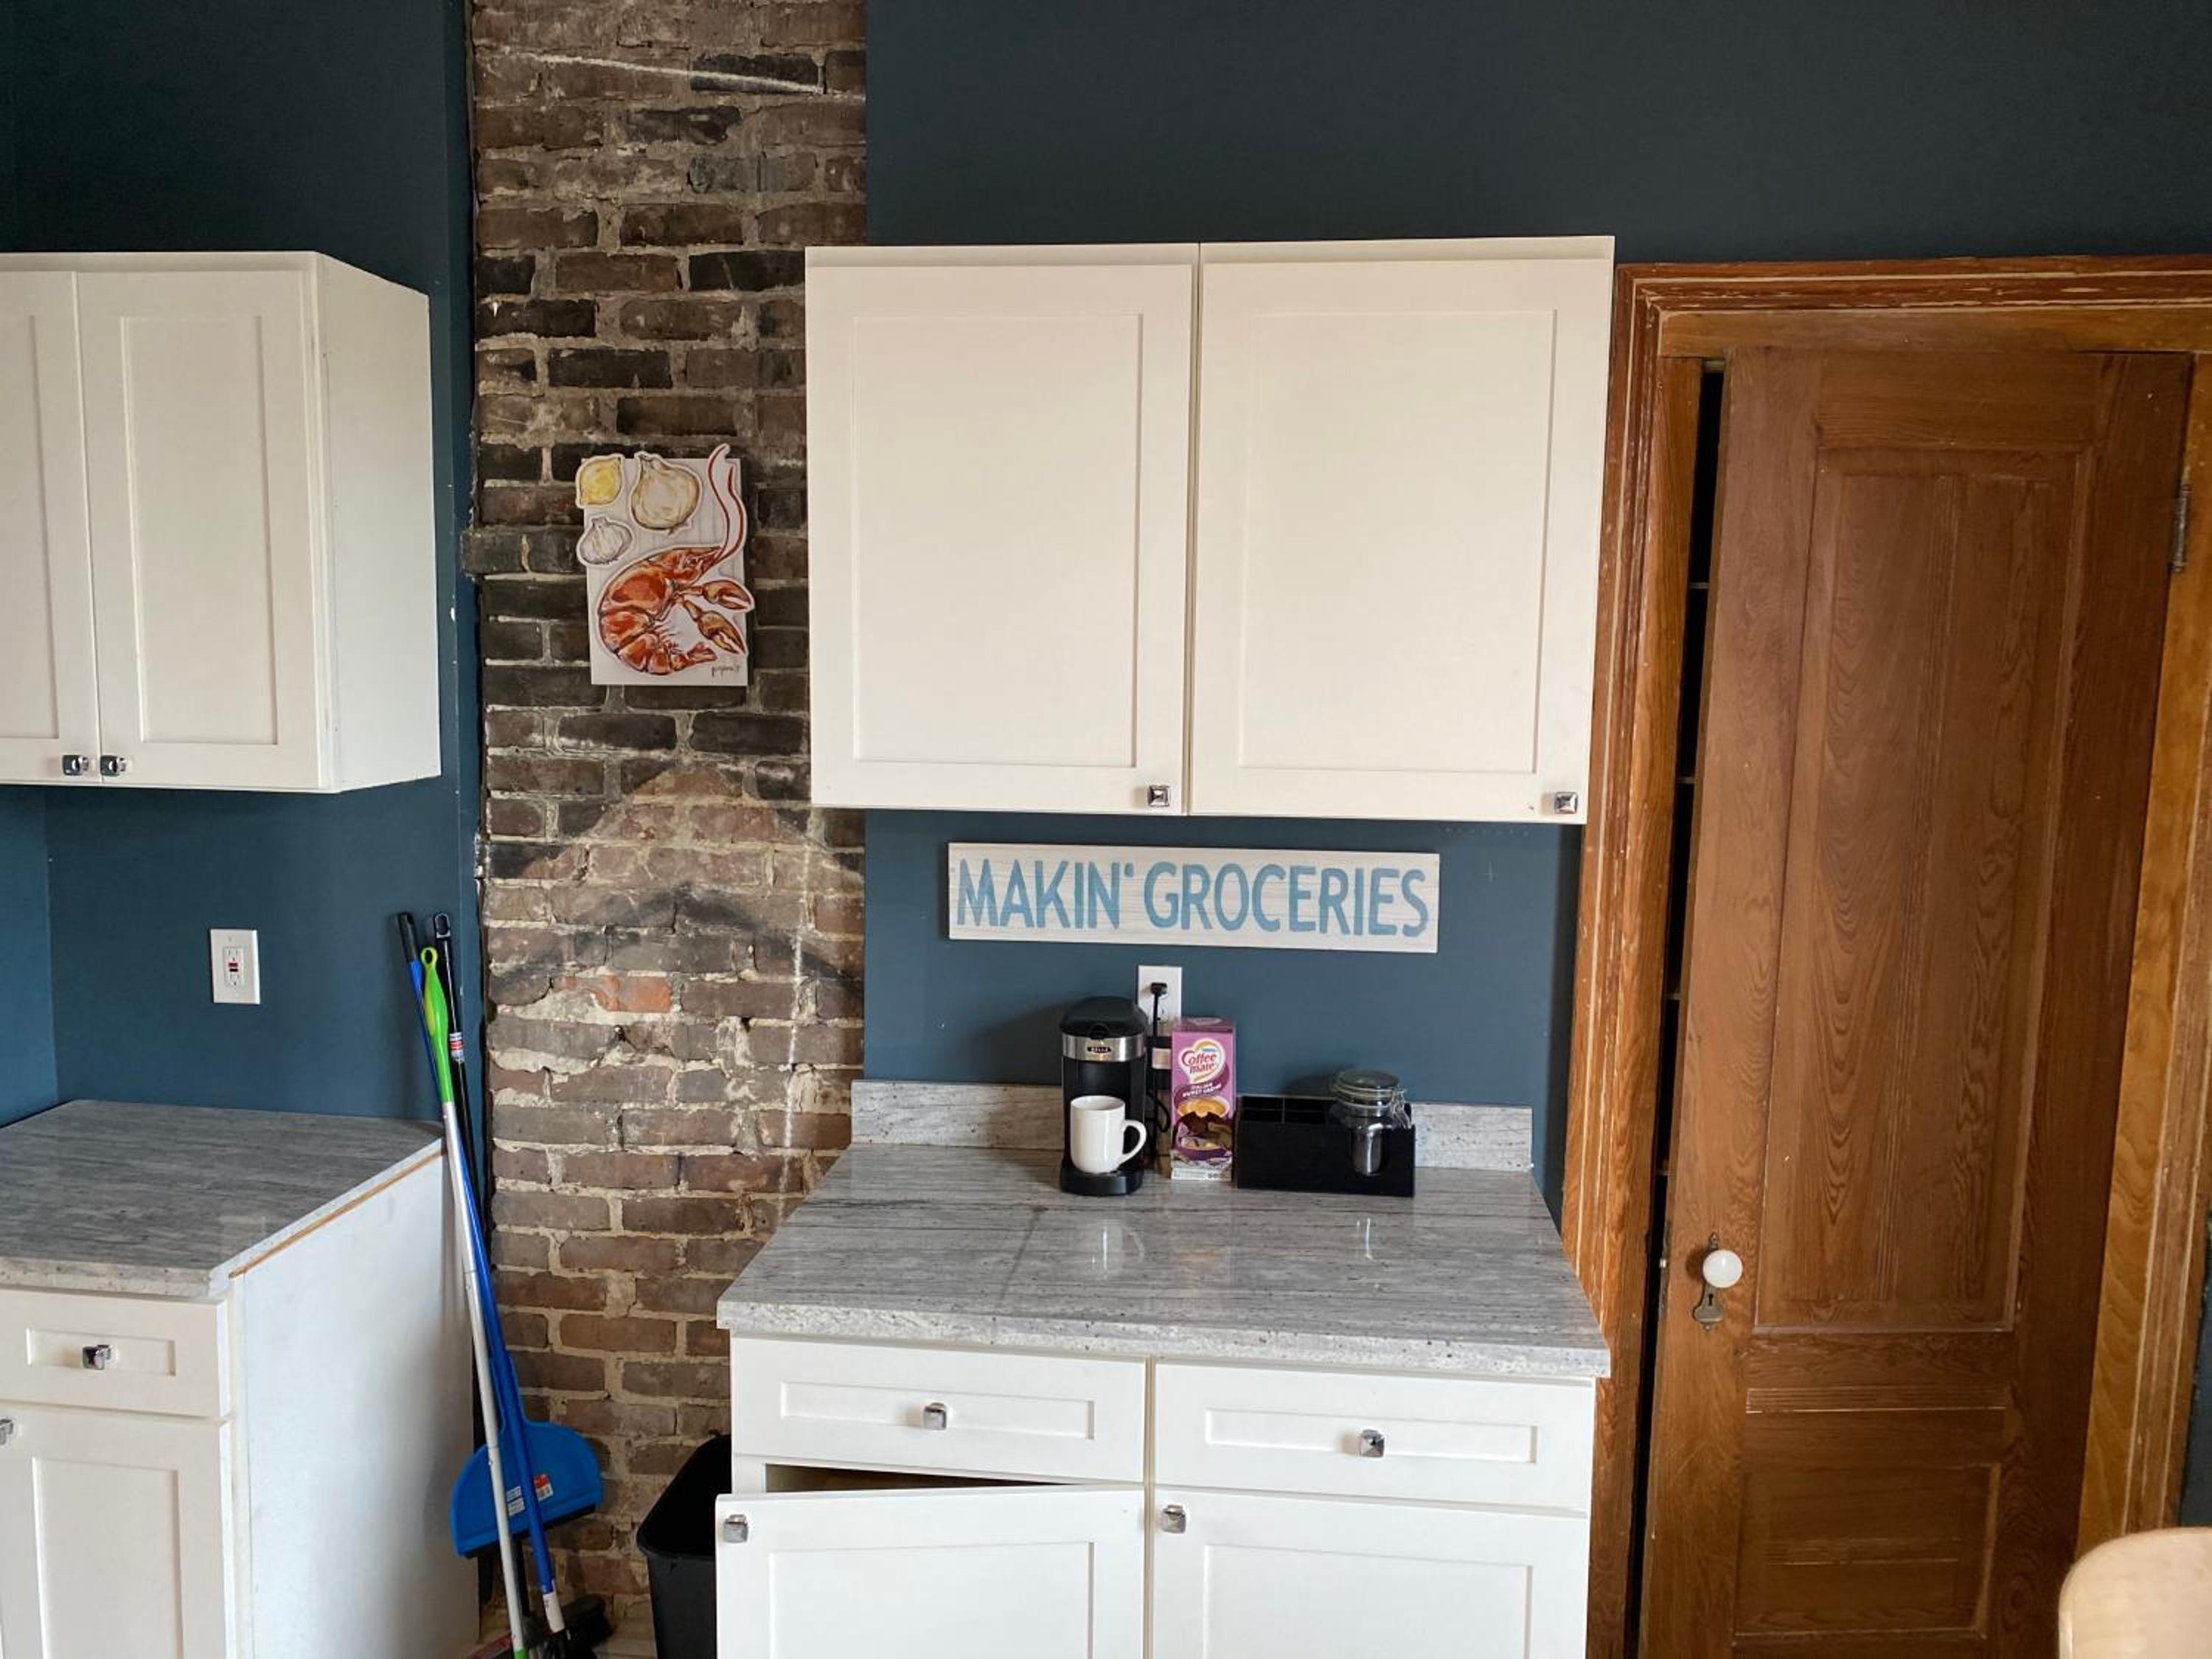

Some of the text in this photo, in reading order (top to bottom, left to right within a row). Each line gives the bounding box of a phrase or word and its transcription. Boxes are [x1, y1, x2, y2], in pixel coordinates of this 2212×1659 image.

[957, 859, 1428, 937] MAKIN' GROCERIES
[1181, 1050, 1217, 1066] Coffee
[1189, 1062, 1214, 1074] mate
